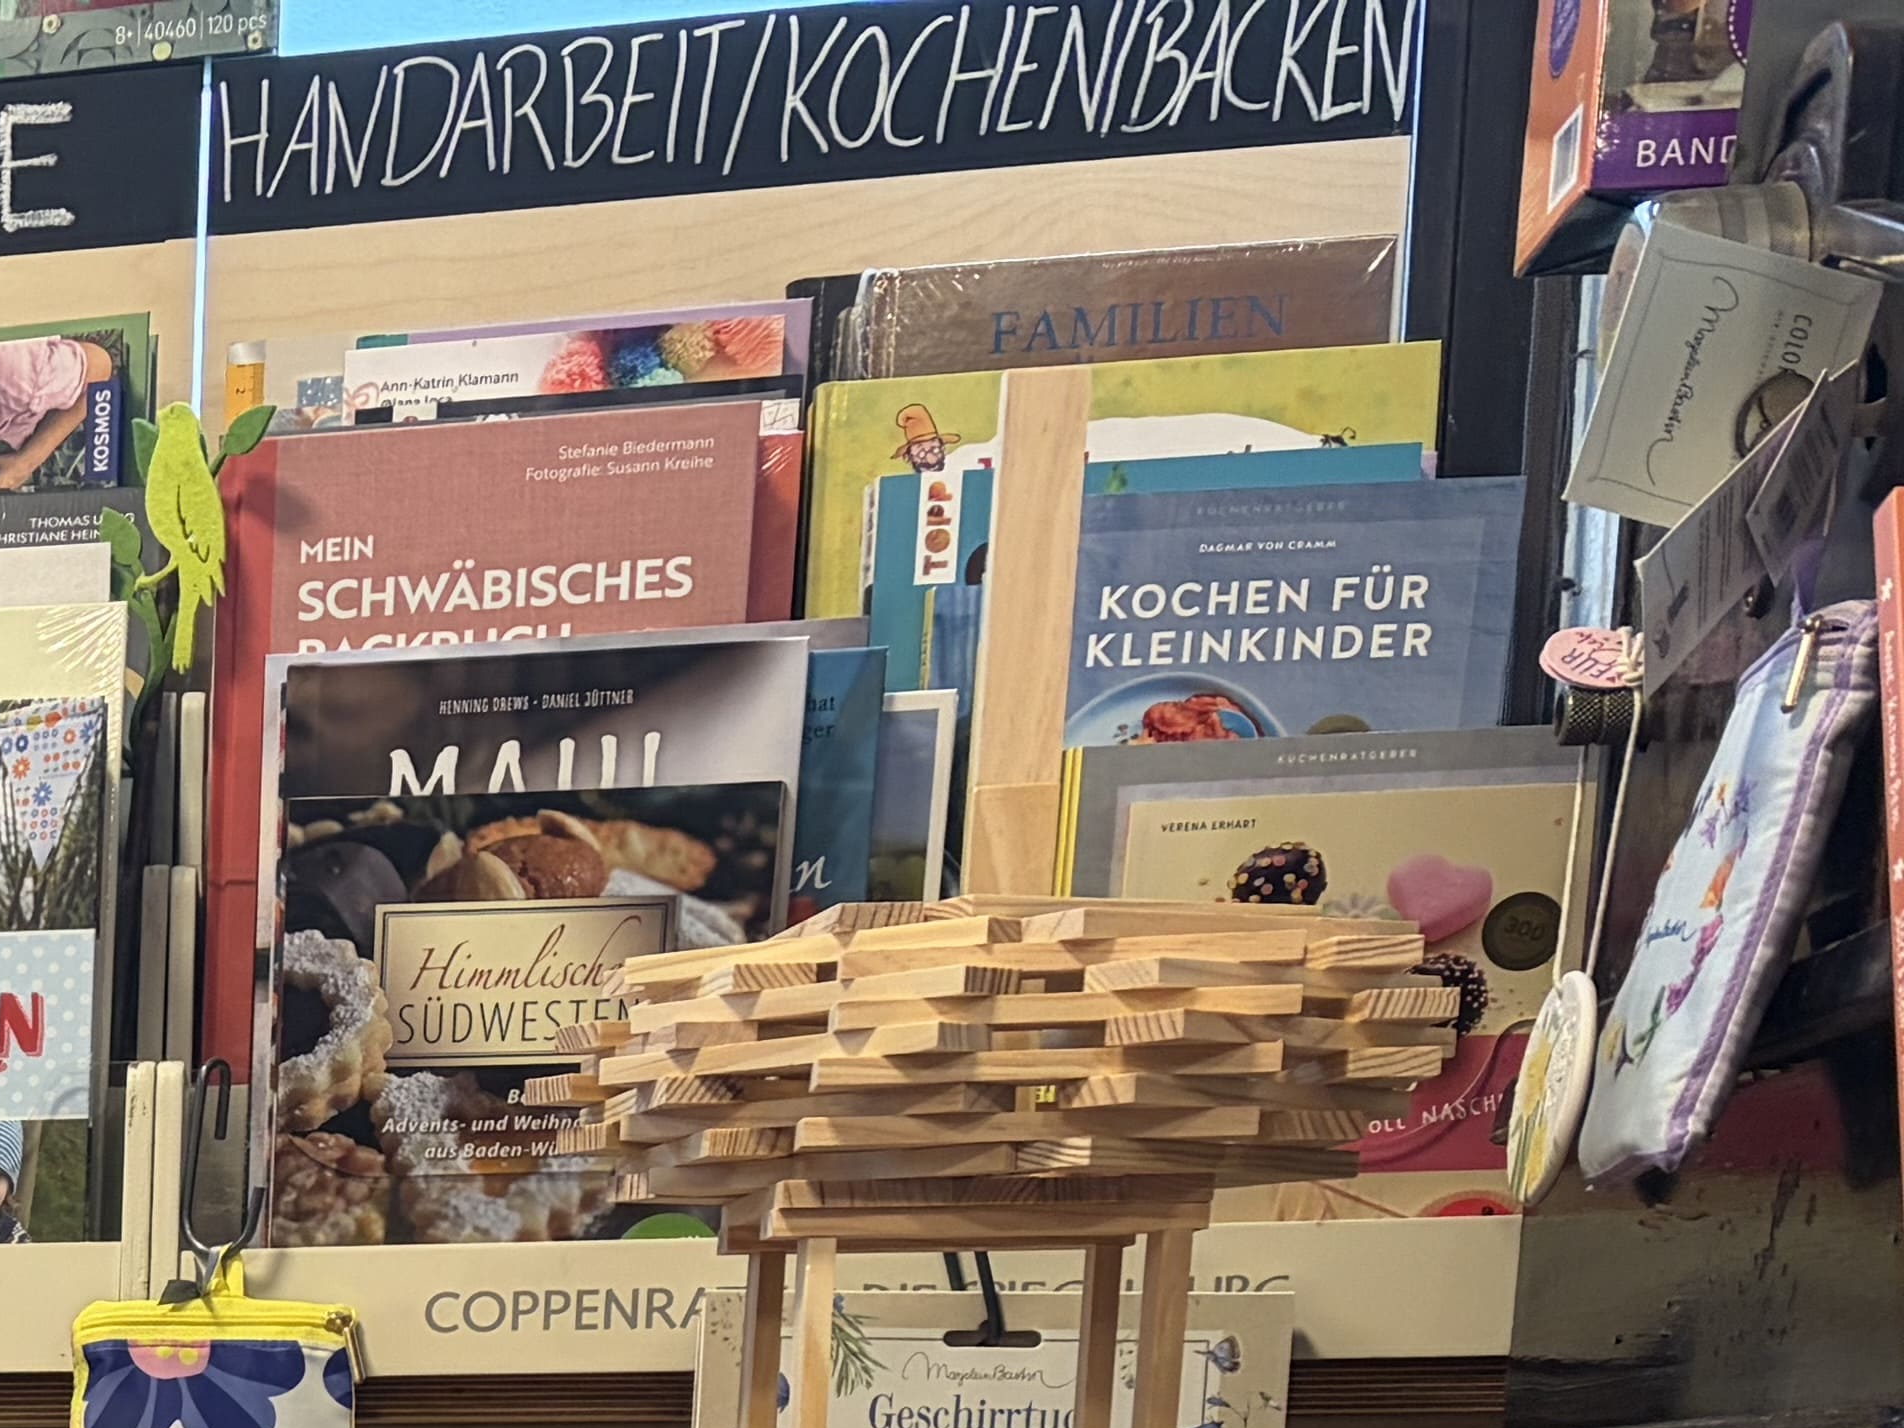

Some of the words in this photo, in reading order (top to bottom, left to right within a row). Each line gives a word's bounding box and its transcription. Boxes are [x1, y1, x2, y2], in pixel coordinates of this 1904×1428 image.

[142, 17, 197, 42] 40460
[207, 16, 234, 35] 120
[237, 13, 267, 37] pcs
[992, 295, 1285, 356] FAMILIEN
[380, 374, 456, 394] Ann-Katrin
[457, 369, 520, 389] Klamann
[93, 389, 112, 474] KOSMOS
[558, 442, 618, 461] Stefanie
[621, 435, 715, 456] Biedermann
[606, 457, 661, 476] Susann
[29, 515, 89, 530] THOMAS
[922, 480, 955, 577] TOPP
[299, 535, 375, 565] MEIN
[1198, 541, 1254, 554] DAGMAR
[1257, 540, 1284, 552] VON
[297, 556, 694, 622] SCHWÄBISCHES
[1098, 577, 1310, 621] KOCHEN
[1331, 564, 1430, 612] FÜR
[1084, 622, 1433, 669] KLEINKINDER
[1161, 820, 1208, 833] VERENA
[1211, 818, 1257, 831] ERHART
